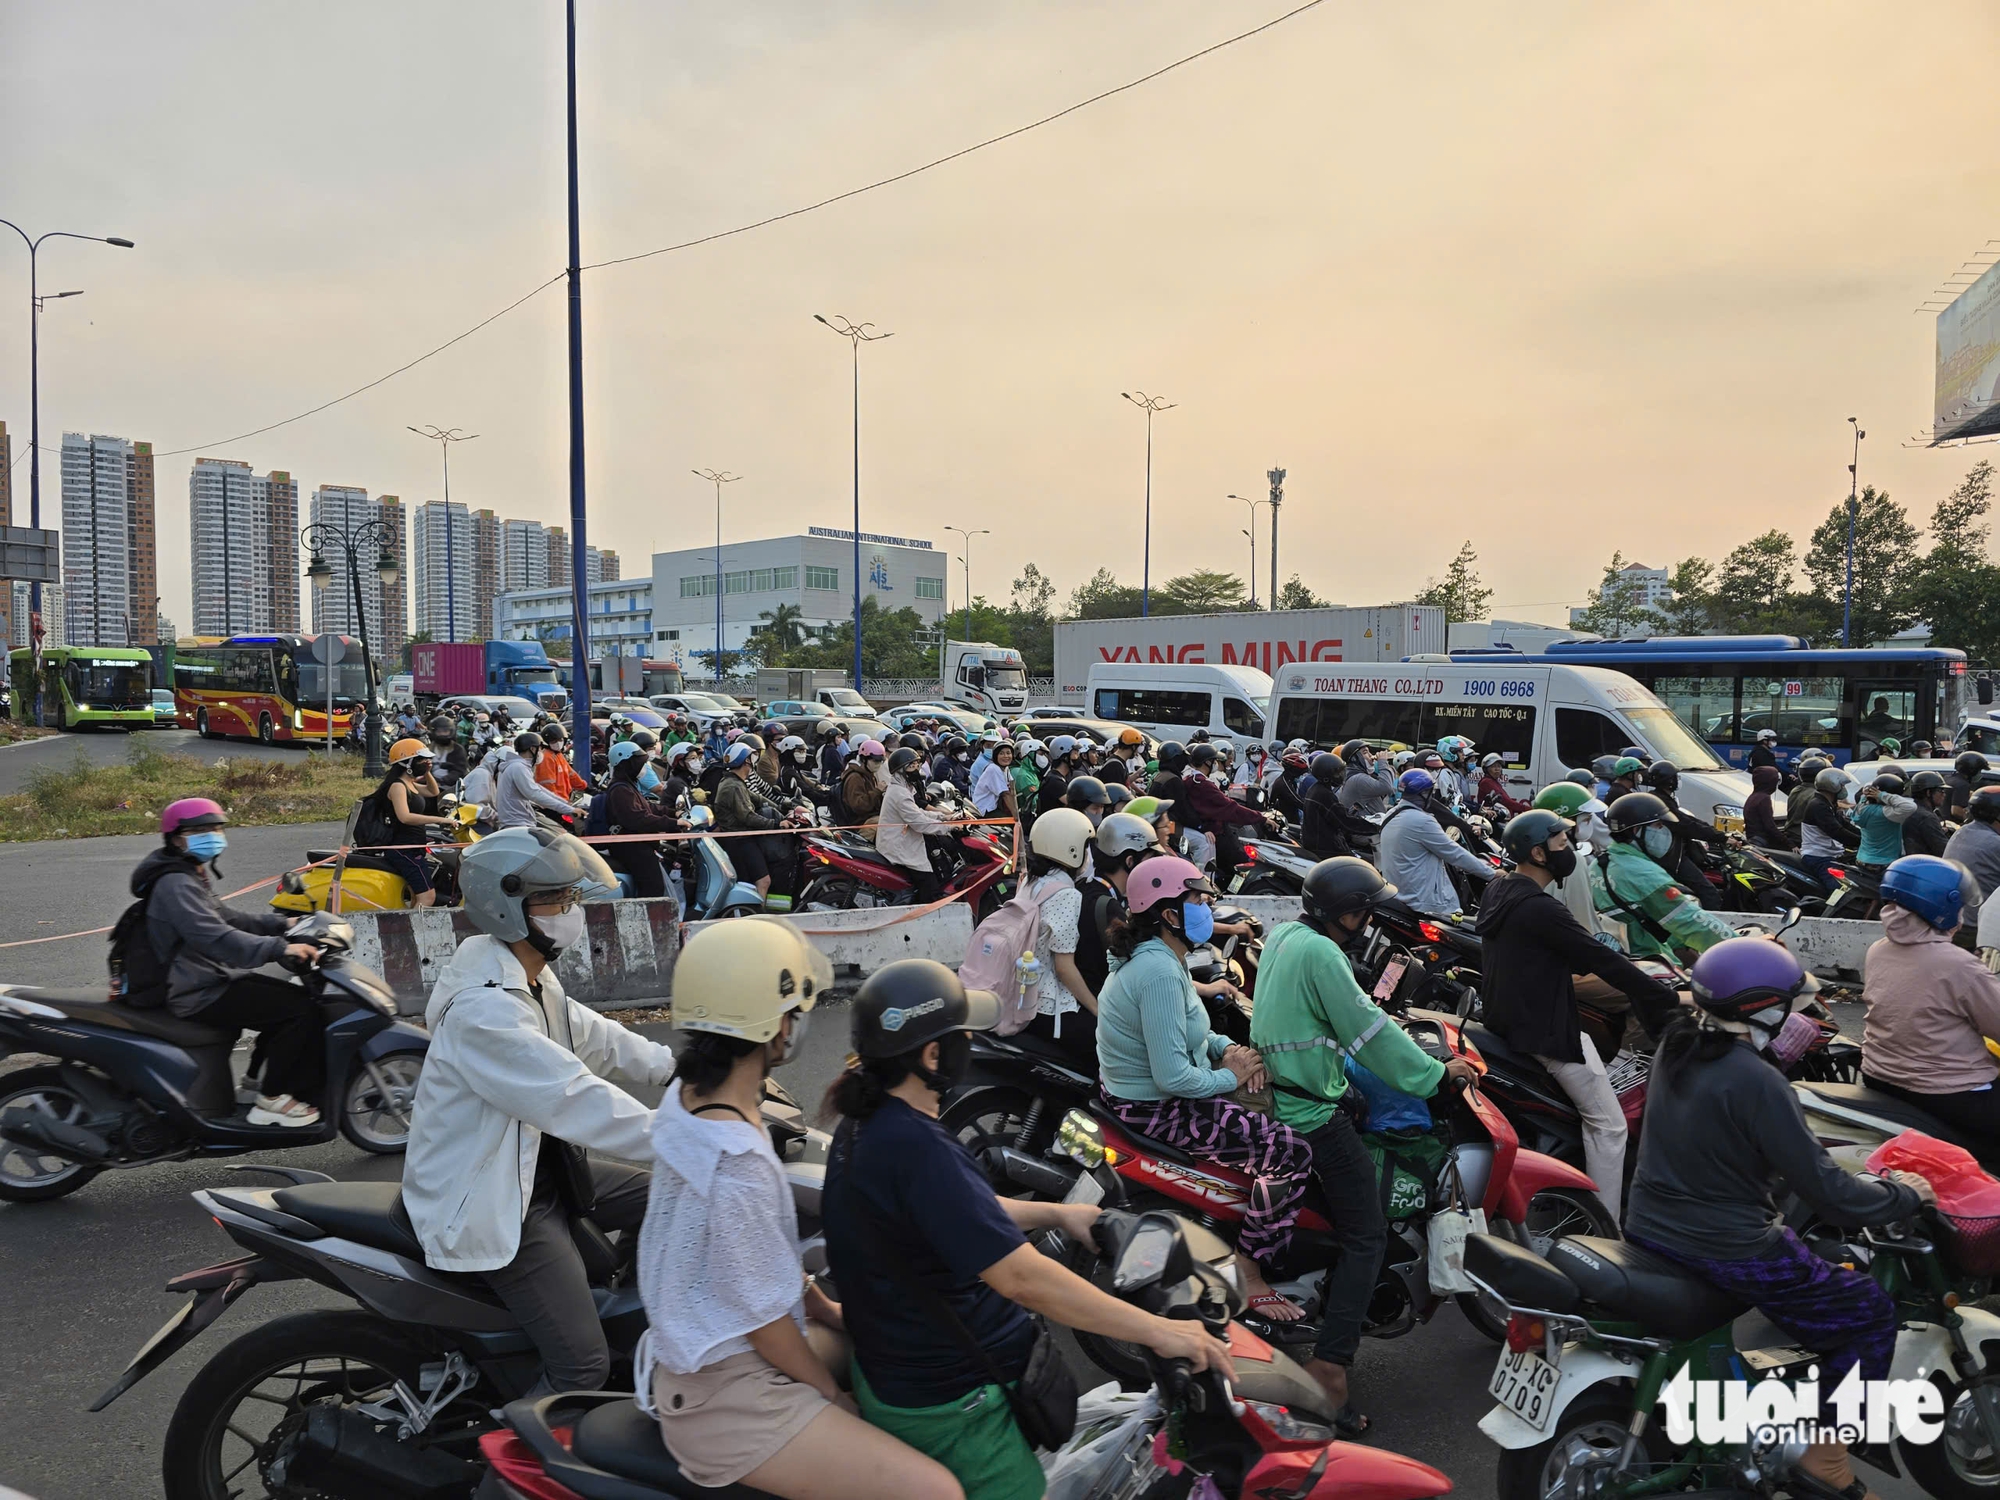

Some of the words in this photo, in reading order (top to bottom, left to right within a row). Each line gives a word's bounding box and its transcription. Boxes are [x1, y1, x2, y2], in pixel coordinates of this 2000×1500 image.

[808, 526, 855, 540] AUSTRALIAN
[857, 532, 907, 547] NTERNATIONAL
[909, 539, 933, 550] SCHOOL
[418, 651, 435, 677] ONE
[1099, 643, 1205, 664] YANG
[1222, 639, 1343, 675] MING
[1314, 678, 1345, 692] TOAN
[1347, 678, 1388, 694] THANG
[1463, 680, 1496, 696] 1900
[1500, 681, 1535, 697] 6968
[1787, 683, 1801, 695] 99
[1483, 708, 1498, 718] CAO
[1499, 706, 1512, 718] TỐC
[1516, 709, 1528, 721] Q.1
[904, 998, 945, 1020] PIAGGIO
[1556, 1242, 1600, 1270] HONDA
[1494, 1369, 1542, 1421] 0709
